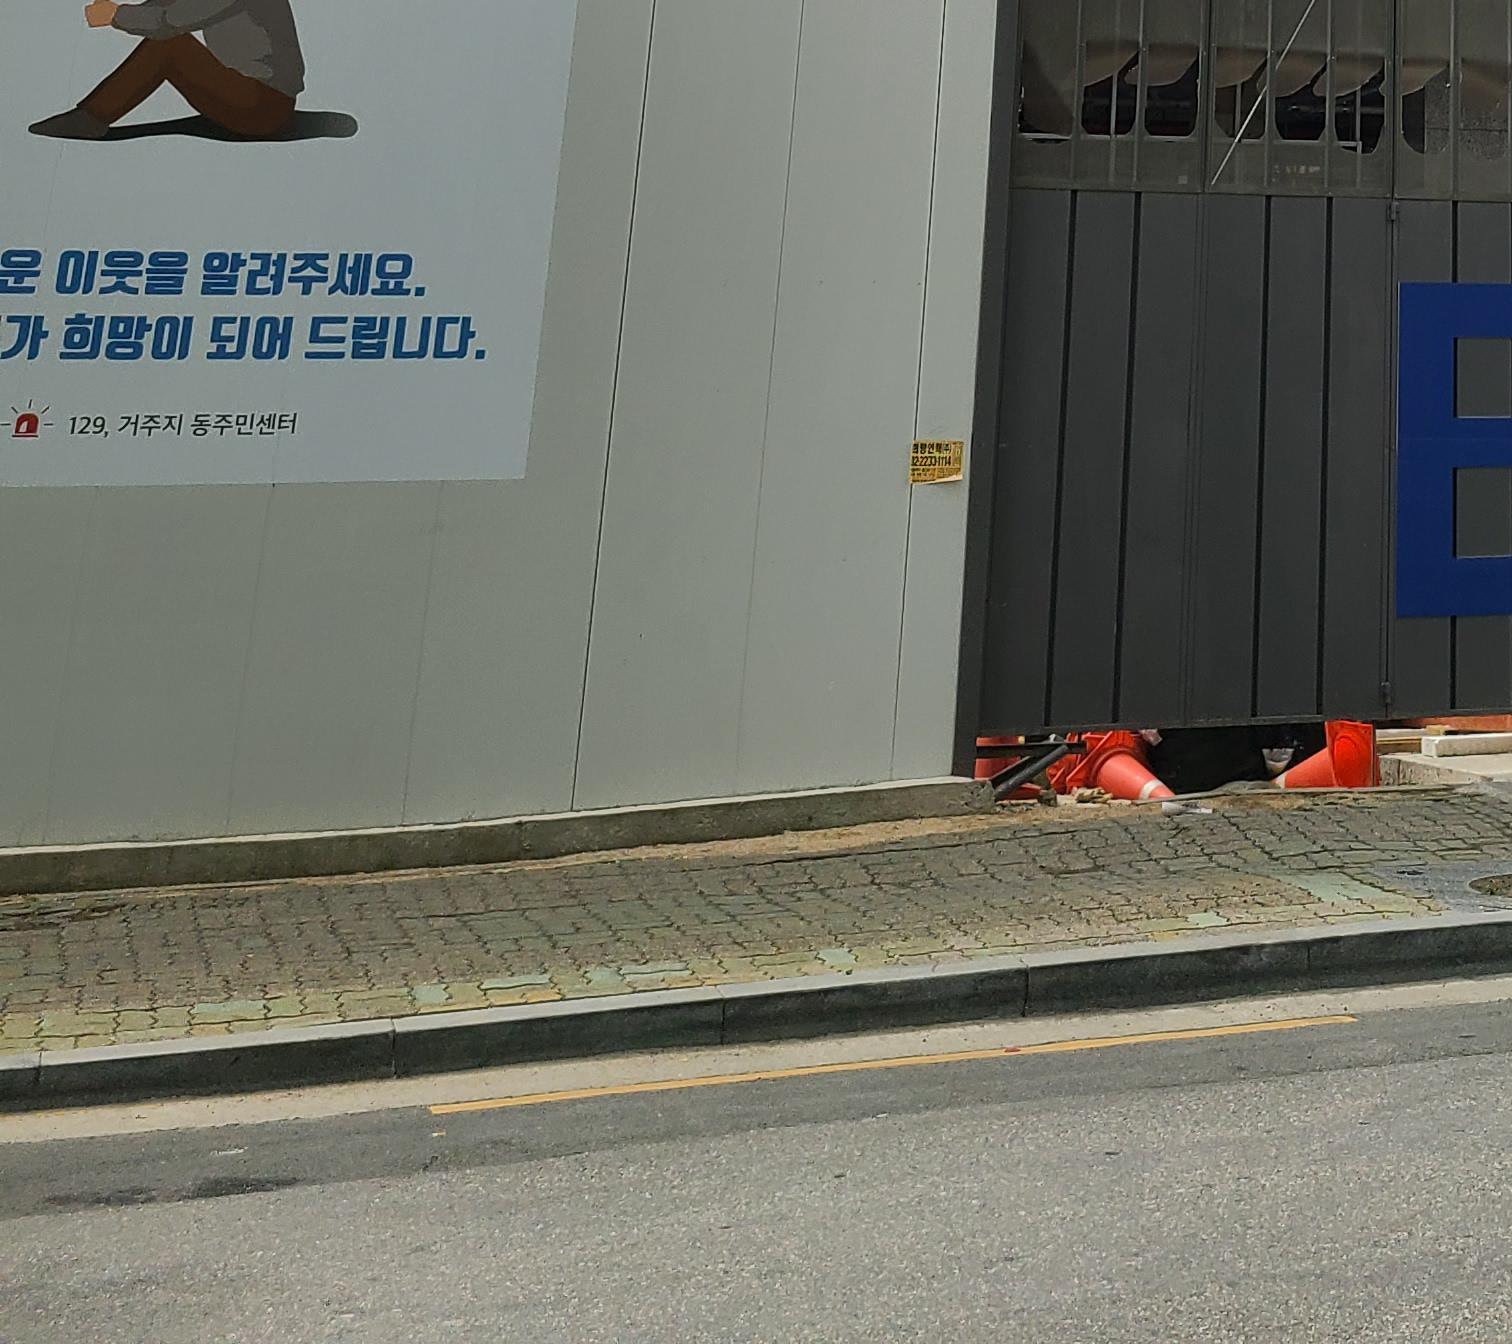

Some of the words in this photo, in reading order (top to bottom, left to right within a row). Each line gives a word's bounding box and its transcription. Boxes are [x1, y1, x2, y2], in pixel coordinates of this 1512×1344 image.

[55, 250, 189, 296] 이웃을
[200, 252, 426, 297] 알려주세요.
[58, 313, 195, 360] 희망이
[206, 316, 294, 360] 되어
[304, 316, 486, 360] 드립니다.
[68, 415, 109, 438] 129,
[117, 414, 183, 436] 거주지
[190, 412, 298, 437] 동주민센터
